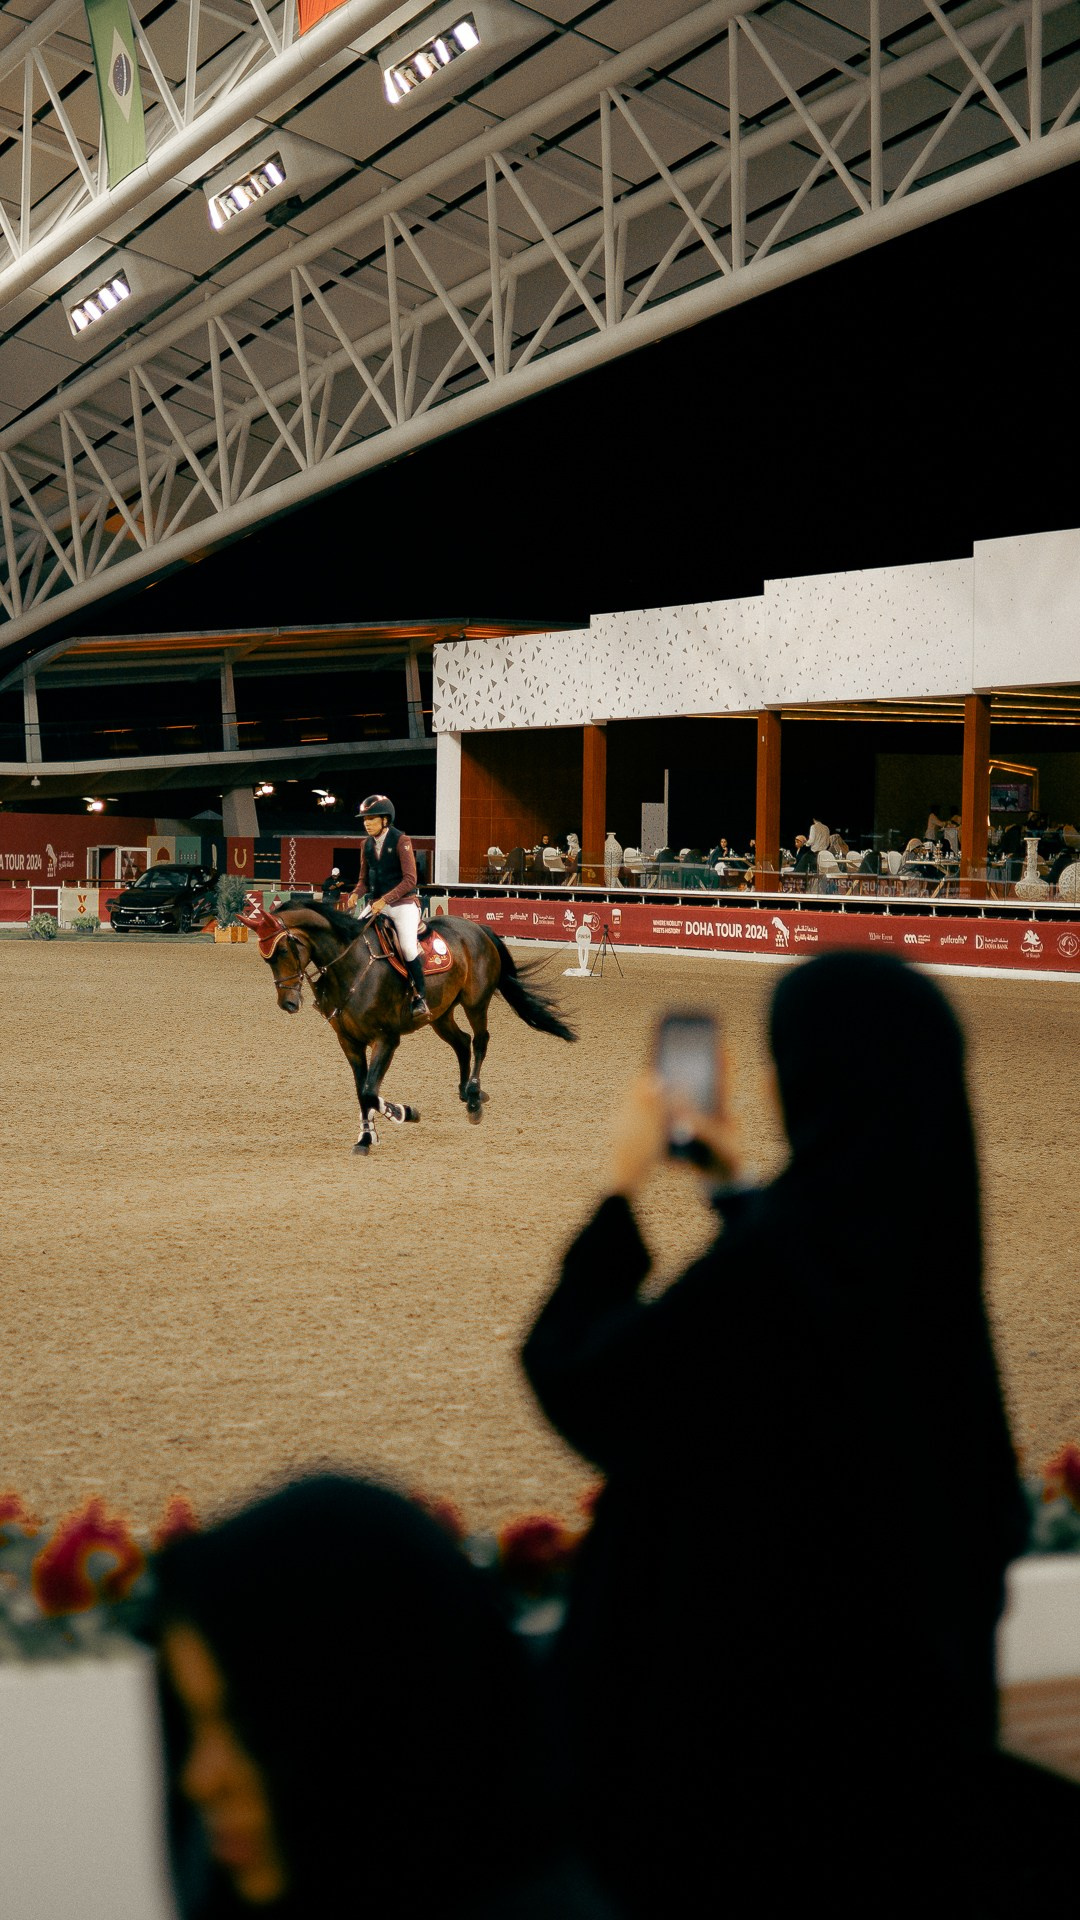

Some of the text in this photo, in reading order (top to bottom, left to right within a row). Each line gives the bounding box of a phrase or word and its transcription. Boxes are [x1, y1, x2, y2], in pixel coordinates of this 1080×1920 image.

[5, 854, 25, 870] TOUR
[26, 854, 42, 870] 2024
[685, 921, 768, 939] DOHA TOUR 2024
[940, 934, 965, 945] gulfcrafts
